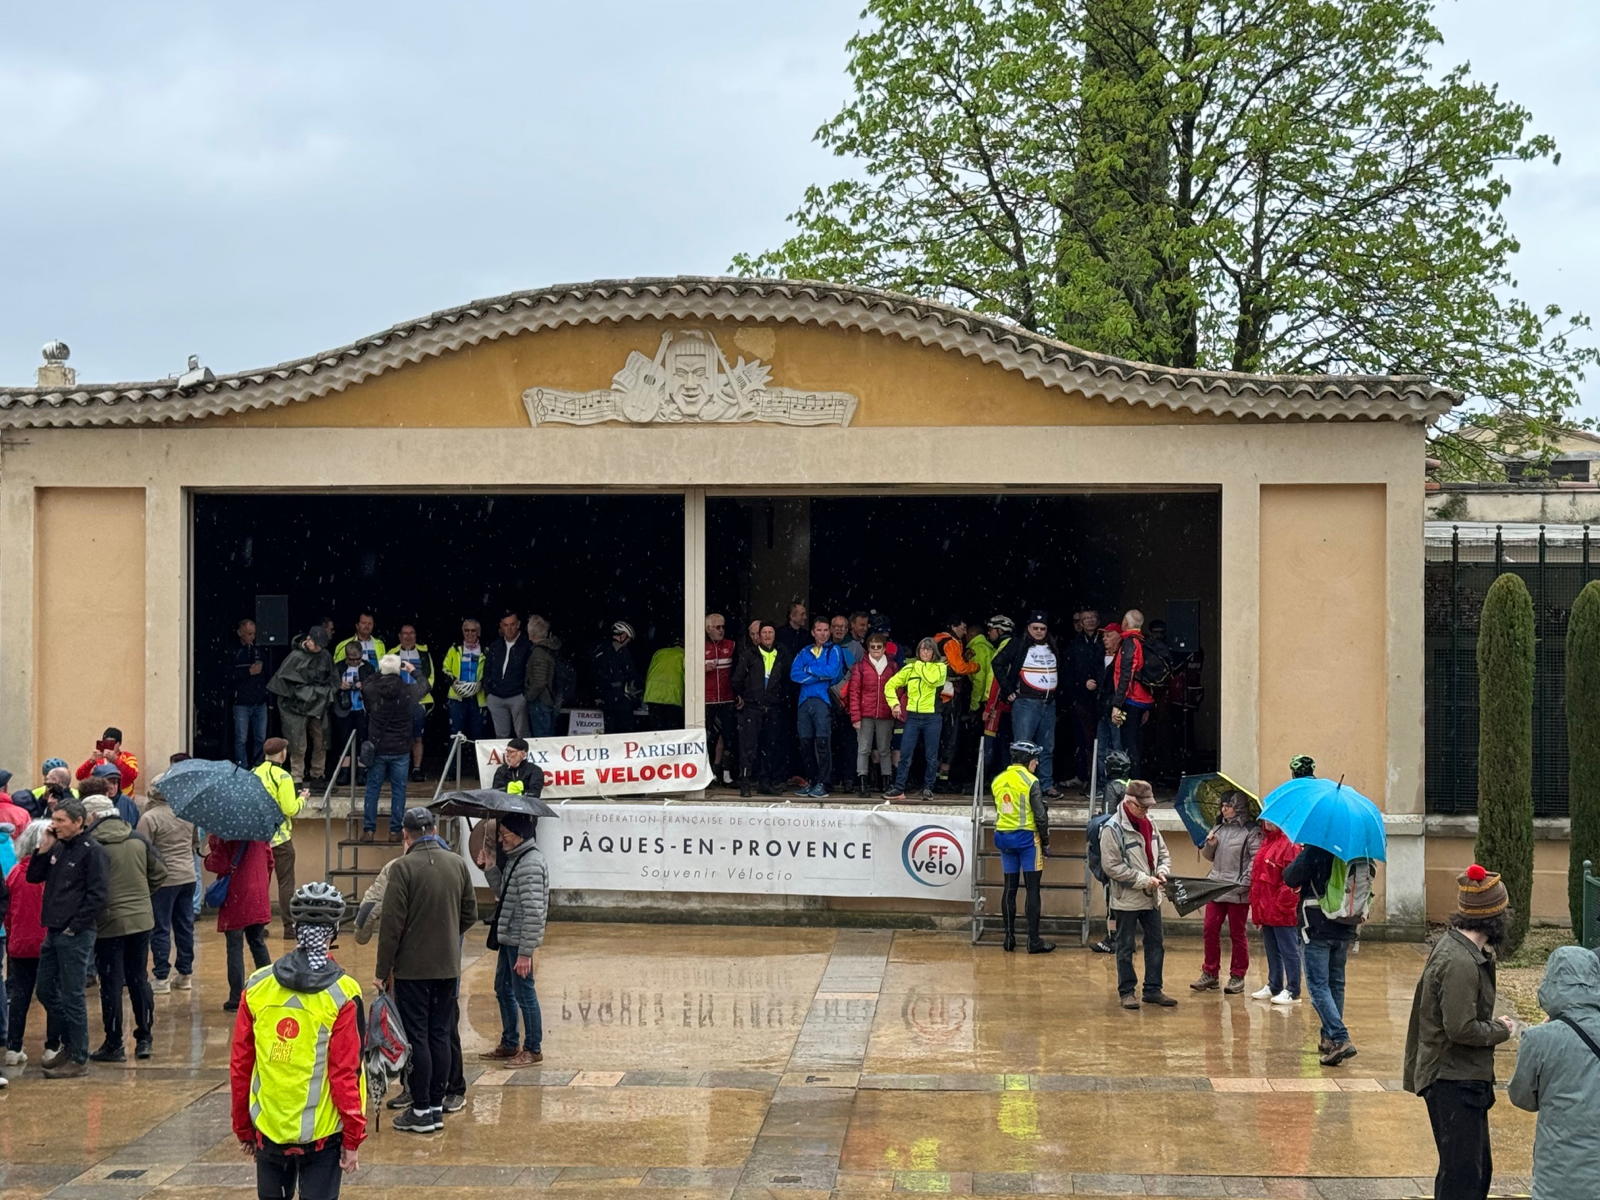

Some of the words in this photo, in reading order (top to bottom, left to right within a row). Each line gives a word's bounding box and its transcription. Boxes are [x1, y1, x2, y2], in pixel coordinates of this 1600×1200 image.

[487, 748, 550, 766] AAX
[561, 744, 609, 762] CLUB
[624, 741, 705, 760] PARISIEN
[543, 769, 585, 787] CHE
[598, 762, 697, 784] VELOCIO
[589, 813, 656, 824] FÉDÉRATION
[662, 815, 723, 825] FRANÇAISE
[729, 817, 743, 826] DE
[749, 817, 843, 829] CYCLOTOURISME
[928, 844, 948, 859] FF
[640, 865, 717, 879] Souvenir
[727, 867, 792, 881] Vélocio
[912, 856, 957, 876] vélo
